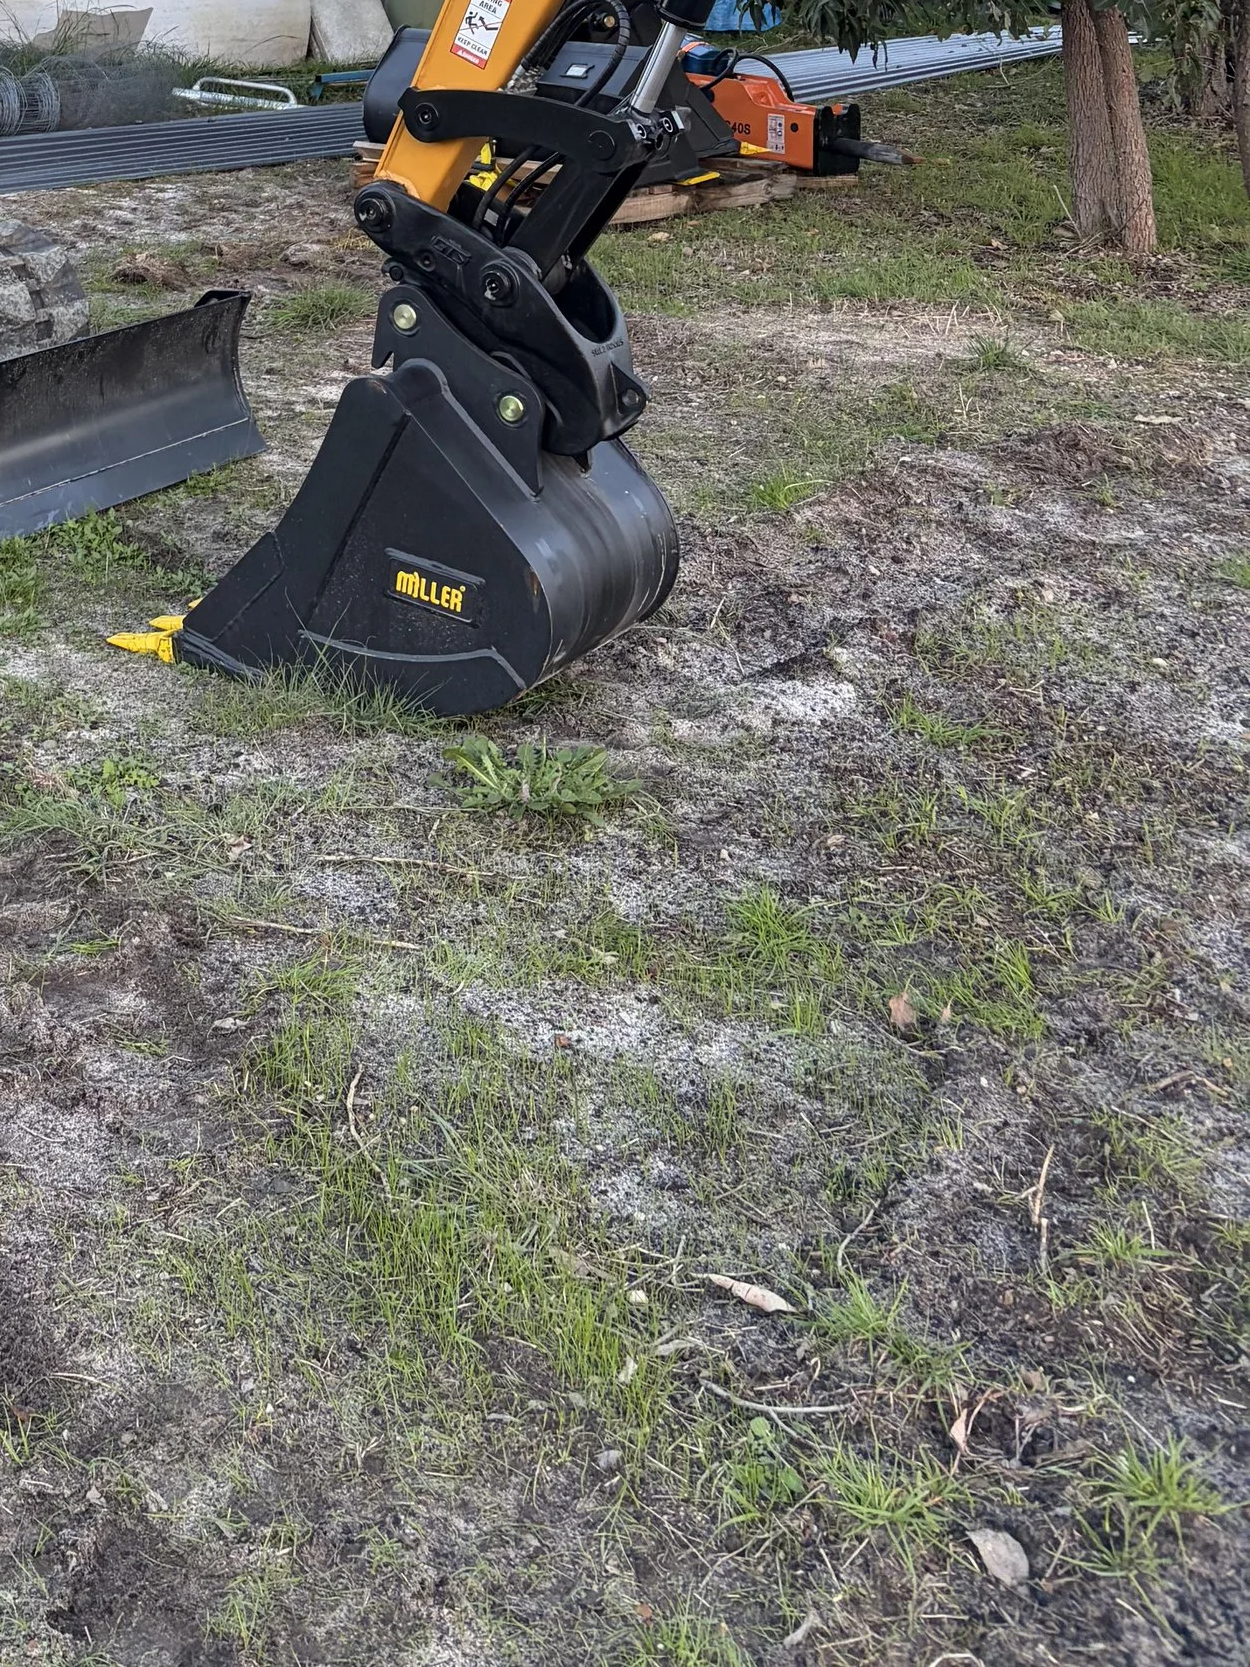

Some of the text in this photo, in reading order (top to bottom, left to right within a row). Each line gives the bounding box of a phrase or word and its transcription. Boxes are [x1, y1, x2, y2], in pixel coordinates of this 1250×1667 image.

[478, 1, 497, 15] AREA
[457, 37, 488, 56] KEEP CLEAR
